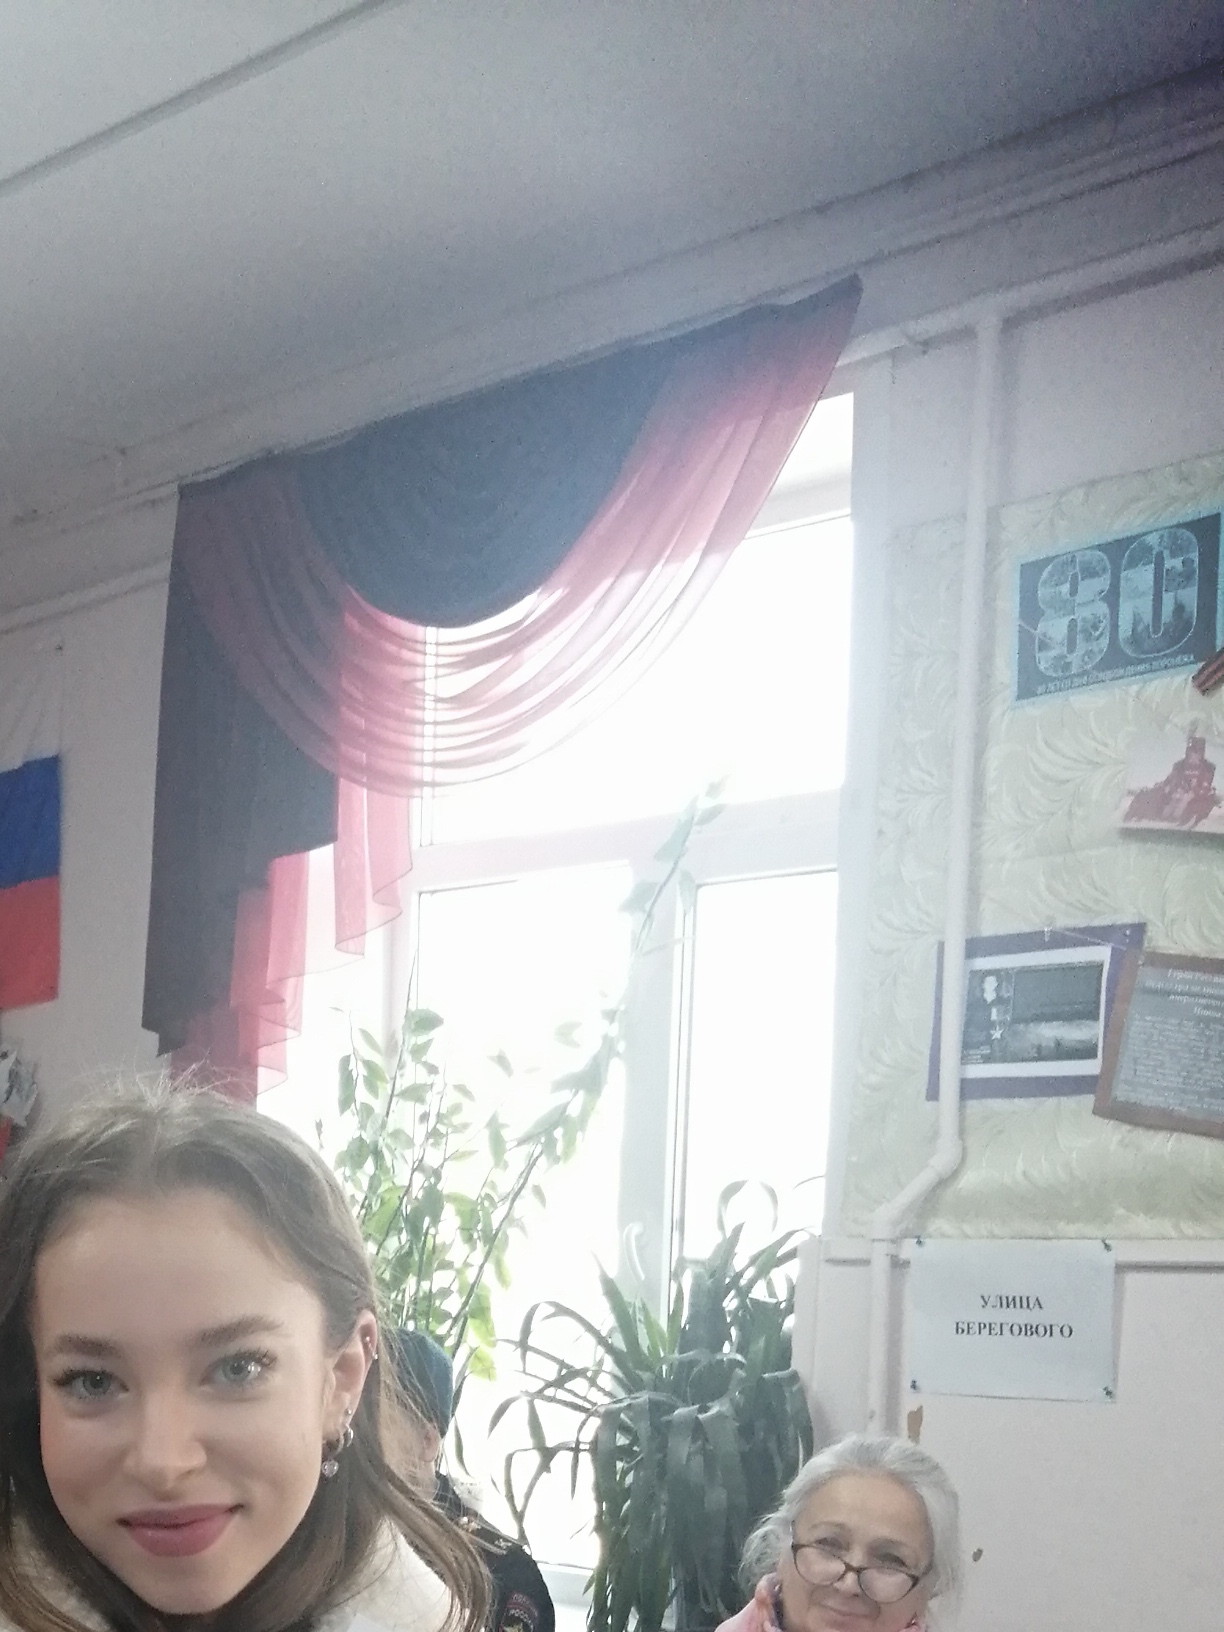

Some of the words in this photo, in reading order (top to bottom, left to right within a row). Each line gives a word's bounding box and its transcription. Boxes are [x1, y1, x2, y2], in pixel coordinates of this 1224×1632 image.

[1034, 527, 1200, 680] 80
[980, 1294, 1044, 1311] УЛИЦА
[954, 1320, 1074, 1339] БЕРЕГОВОГО
